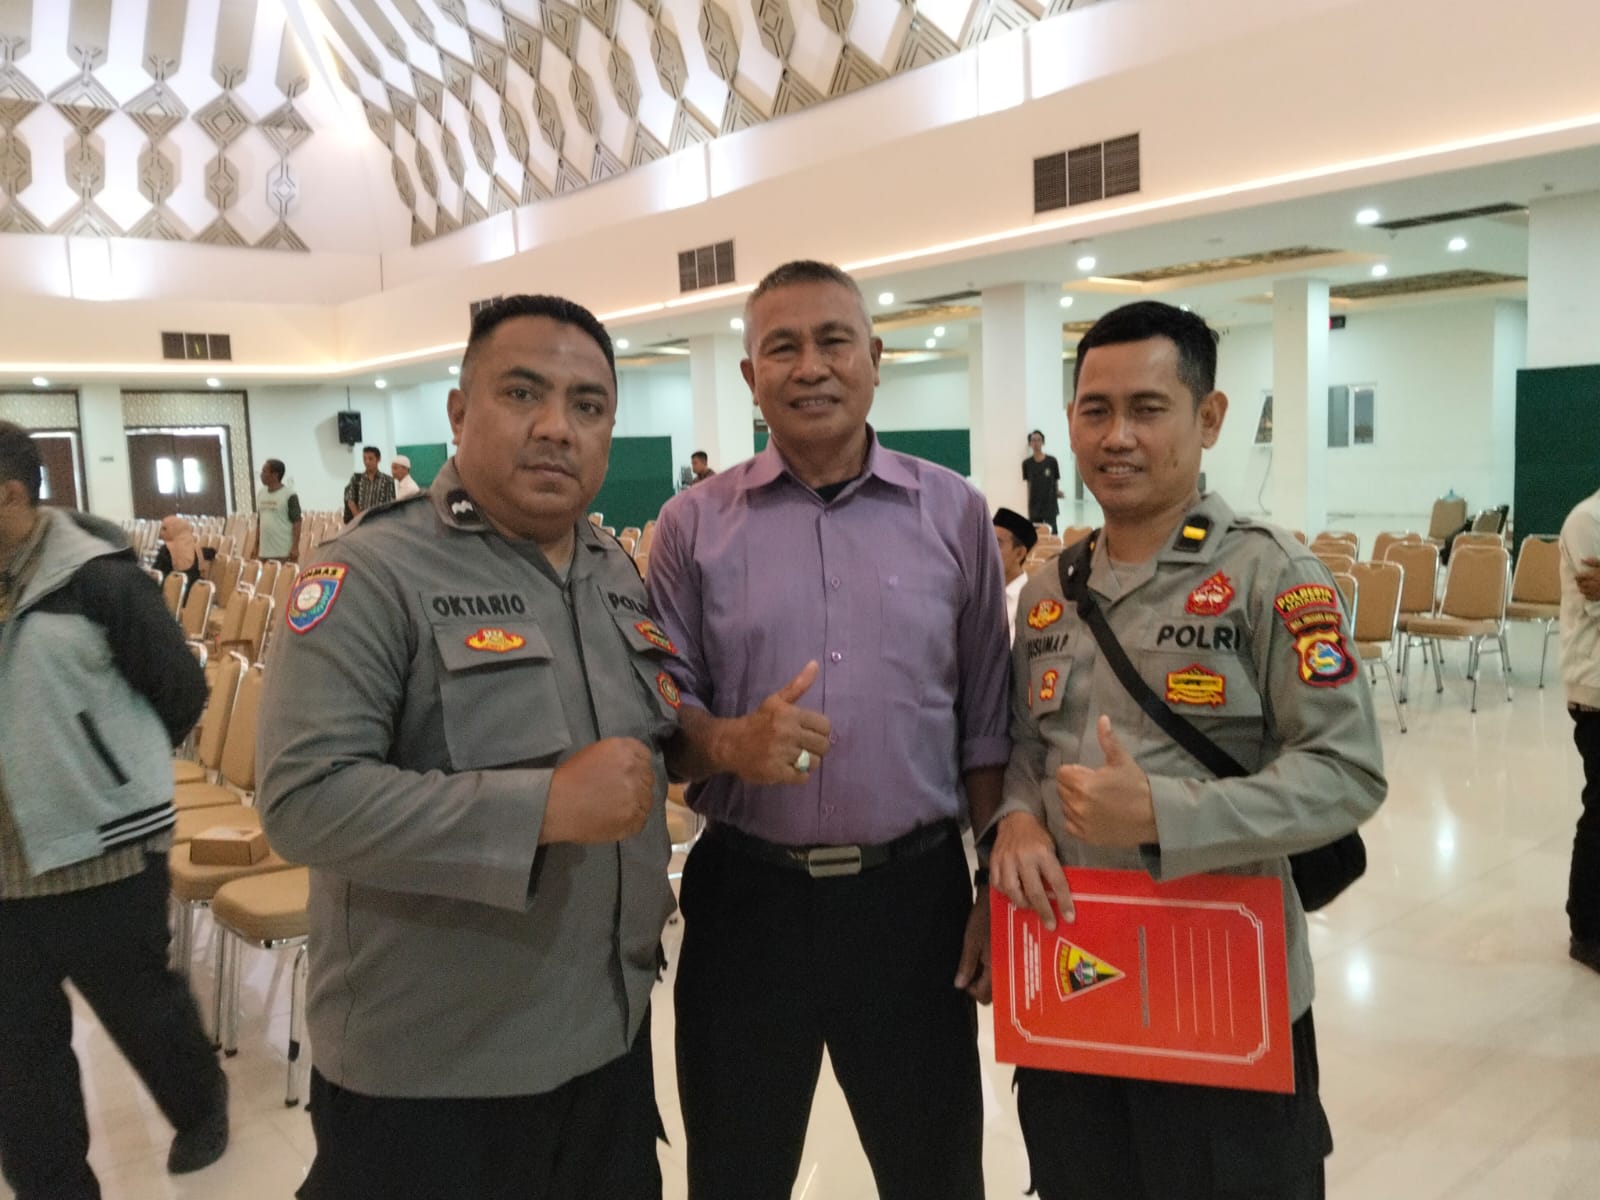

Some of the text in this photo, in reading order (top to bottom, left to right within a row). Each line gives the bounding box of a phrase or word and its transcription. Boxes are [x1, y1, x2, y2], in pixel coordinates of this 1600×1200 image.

[432, 594, 526, 617] OKTARIO
[608, 592, 649, 616] POL
[1156, 625, 1241, 650] POLRI
